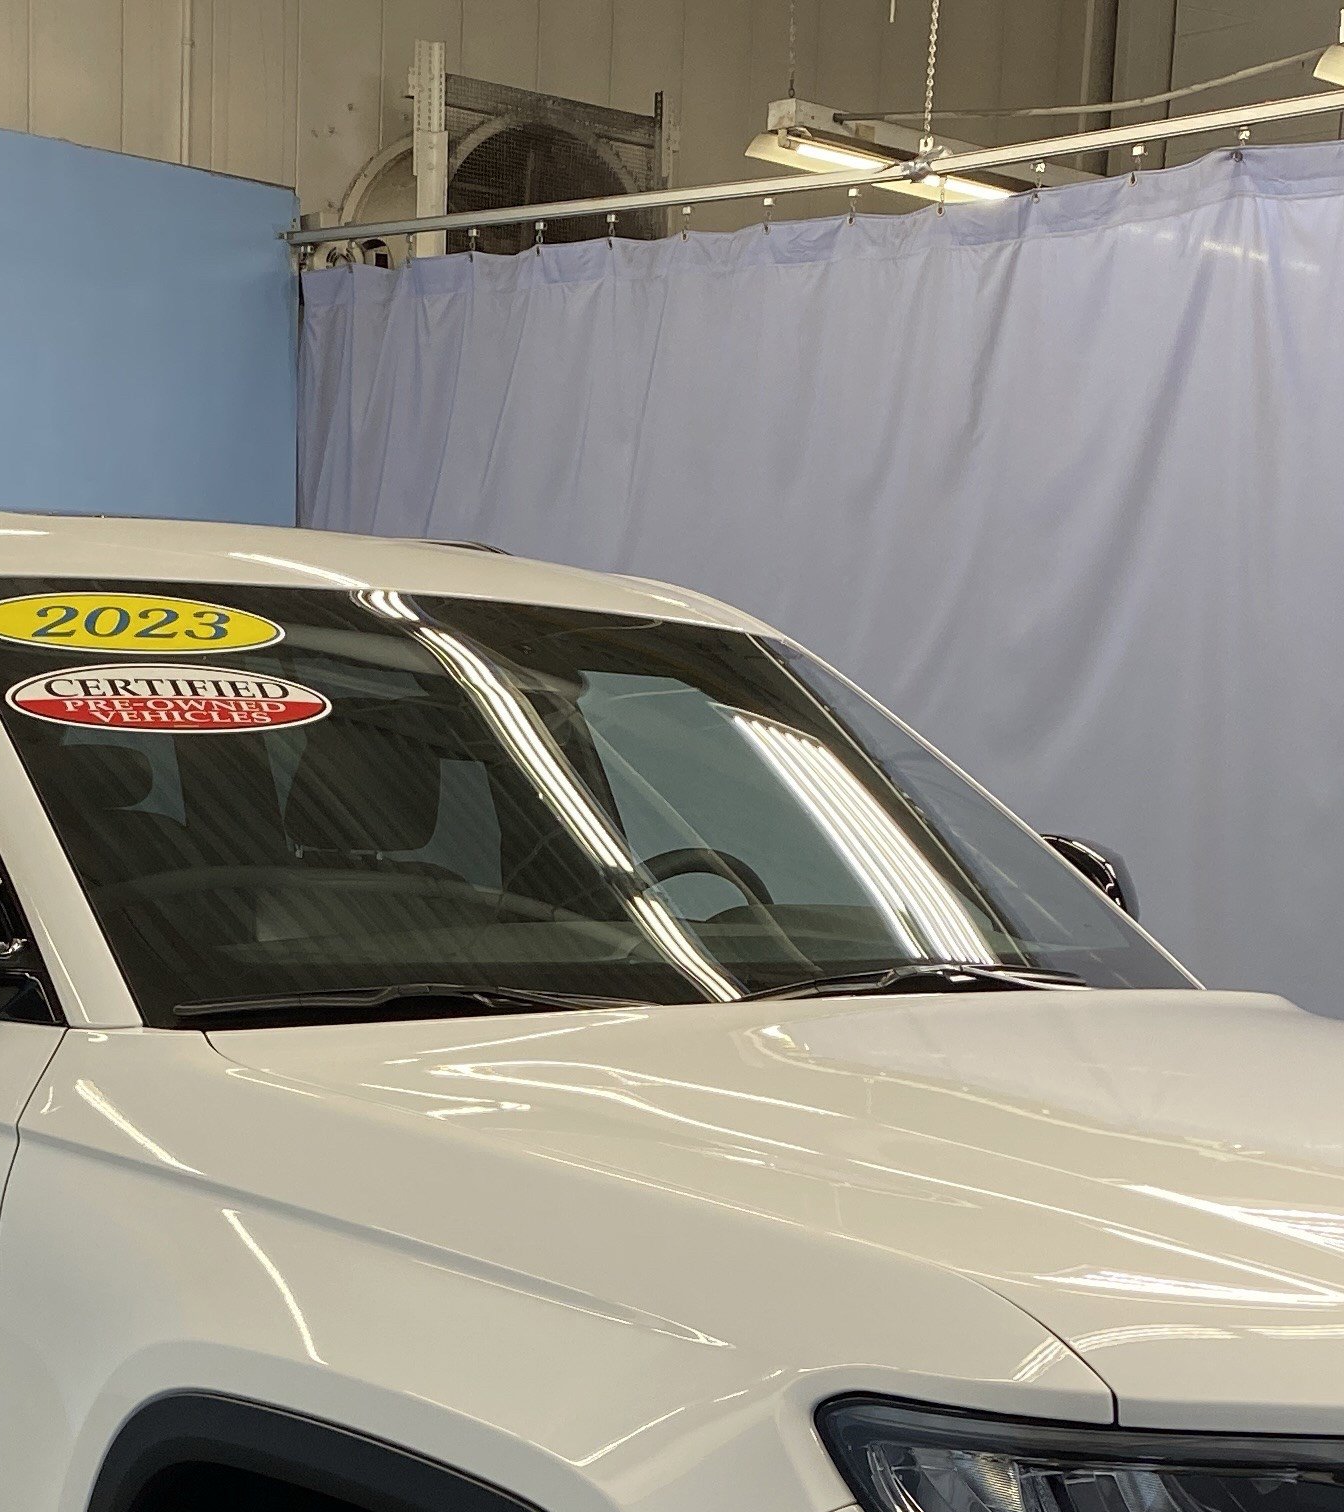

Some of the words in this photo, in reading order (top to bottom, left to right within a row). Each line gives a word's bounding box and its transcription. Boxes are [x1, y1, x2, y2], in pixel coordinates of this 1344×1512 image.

[31, 605, 231, 640] 2023
[44, 678, 290, 700] CERTIFIED
[64, 700, 287, 714] PRE-OWNED
[90, 710, 272, 724] VEHICLES
